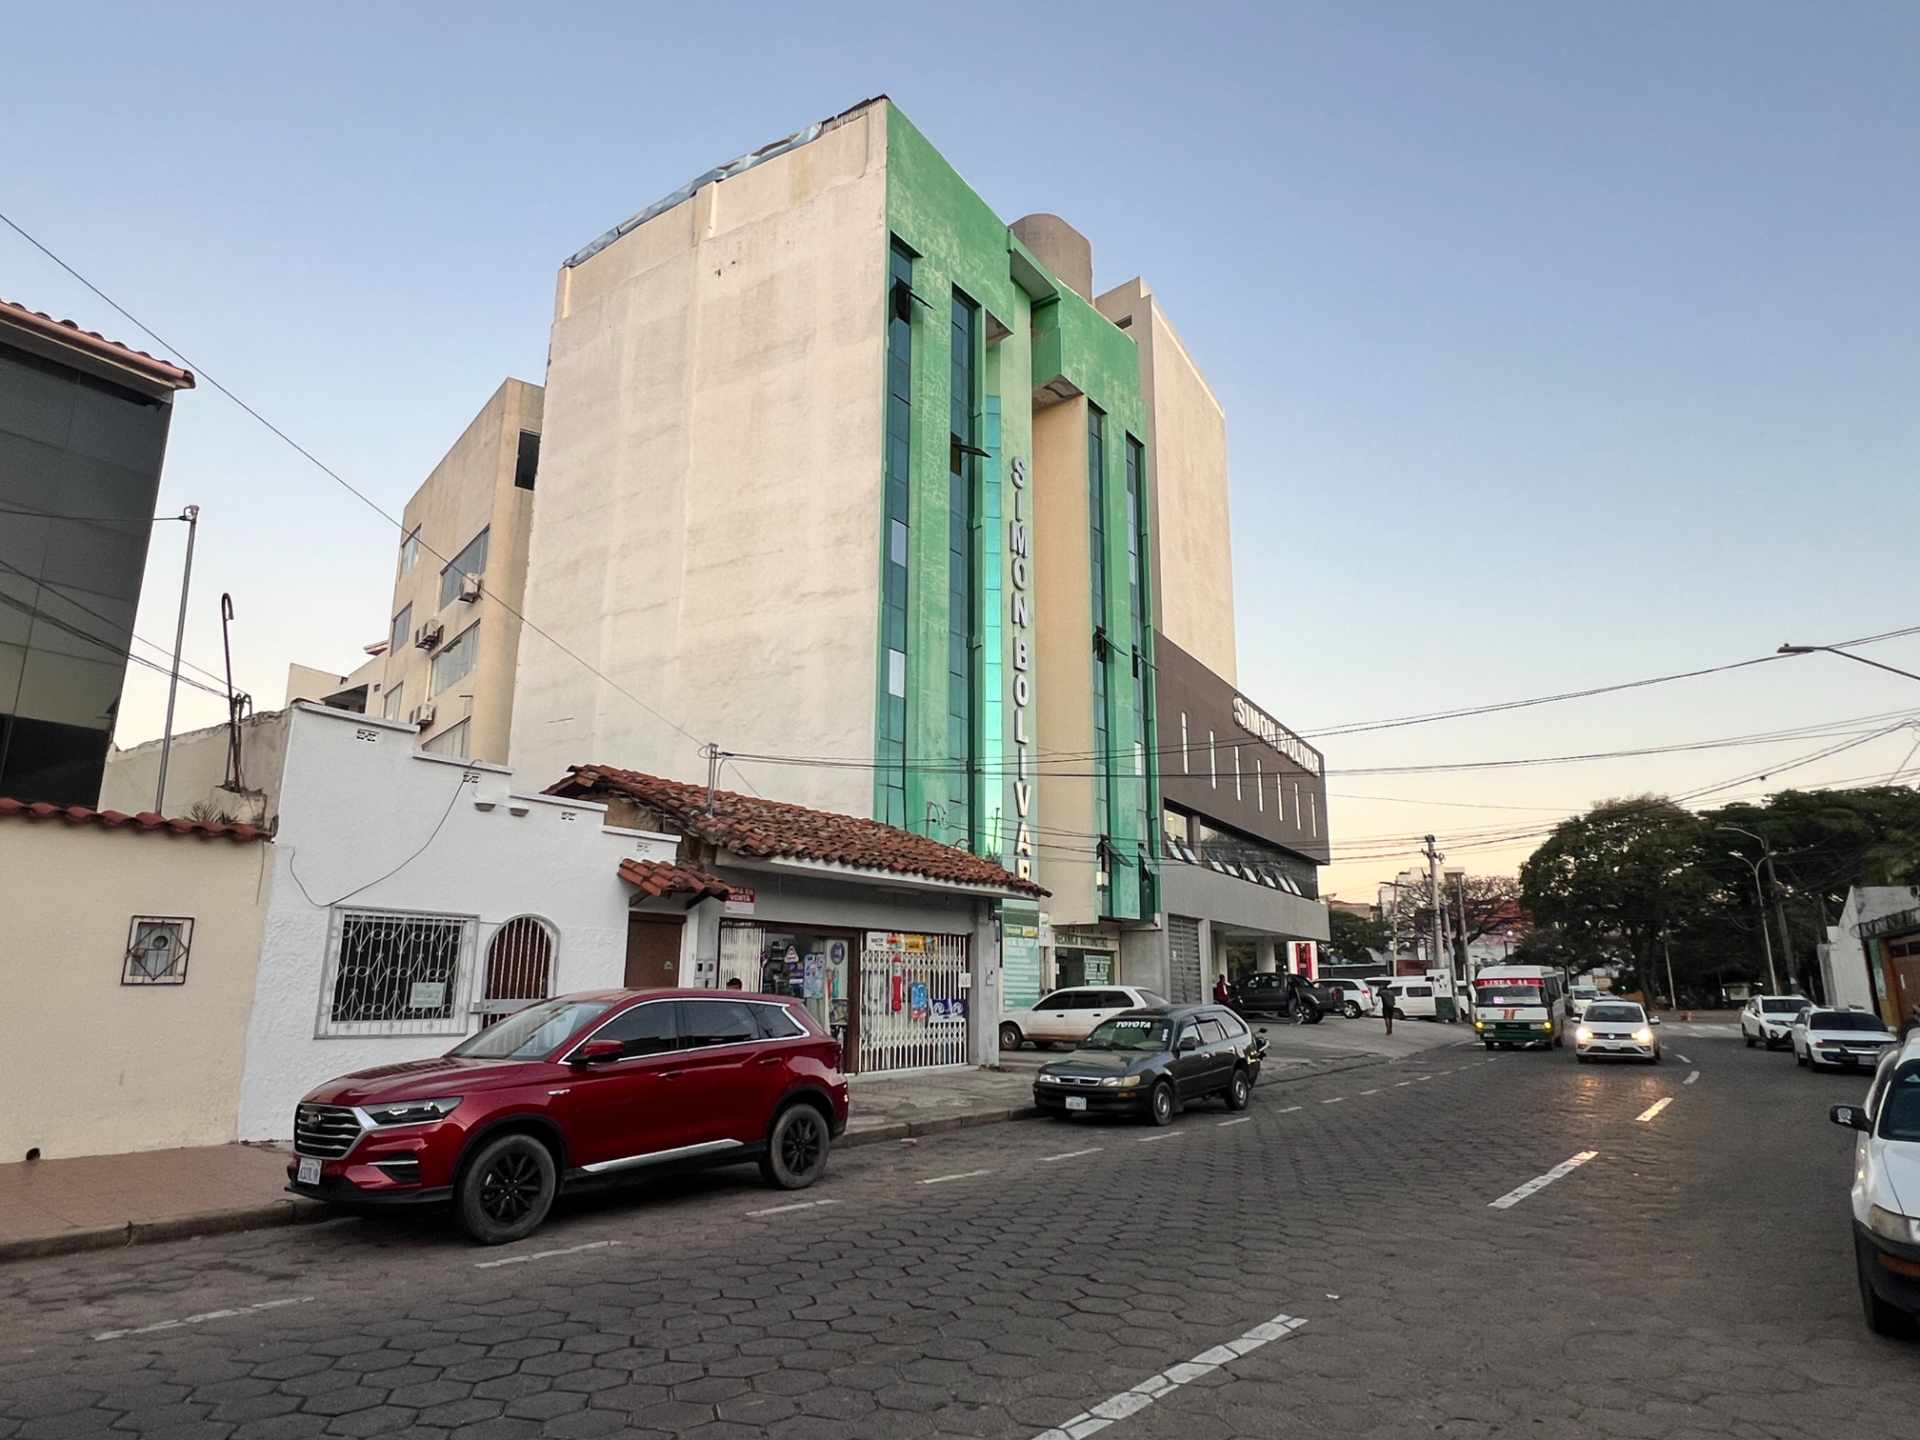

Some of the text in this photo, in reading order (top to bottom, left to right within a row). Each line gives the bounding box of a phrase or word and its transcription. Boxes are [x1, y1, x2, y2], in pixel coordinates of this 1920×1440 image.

[1010, 456, 1031, 880] SIMON BOLIVAR
[1233, 697, 1320, 777] SIMON BOLIVAR
